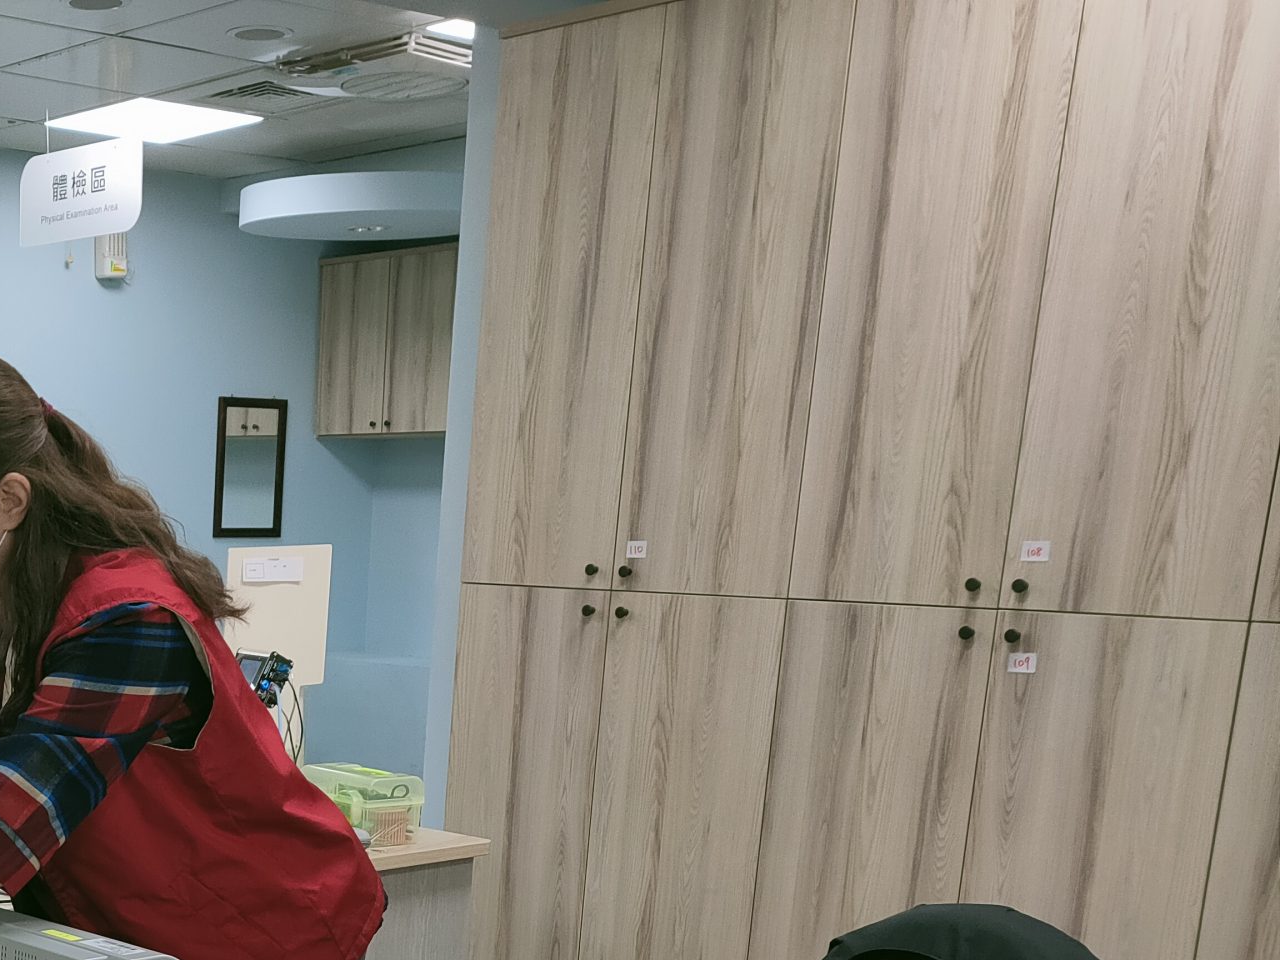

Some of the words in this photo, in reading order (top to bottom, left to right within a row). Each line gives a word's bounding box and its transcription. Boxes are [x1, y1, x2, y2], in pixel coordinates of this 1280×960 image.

[52, 165, 106, 202] 體檢區
[40, 212, 64, 224] Physical
[66, 206, 102, 220] Examination
[104, 203, 118, 213] Area
[1027, 547, 1042, 558] 108
[1013, 656, 1031, 671] 109
